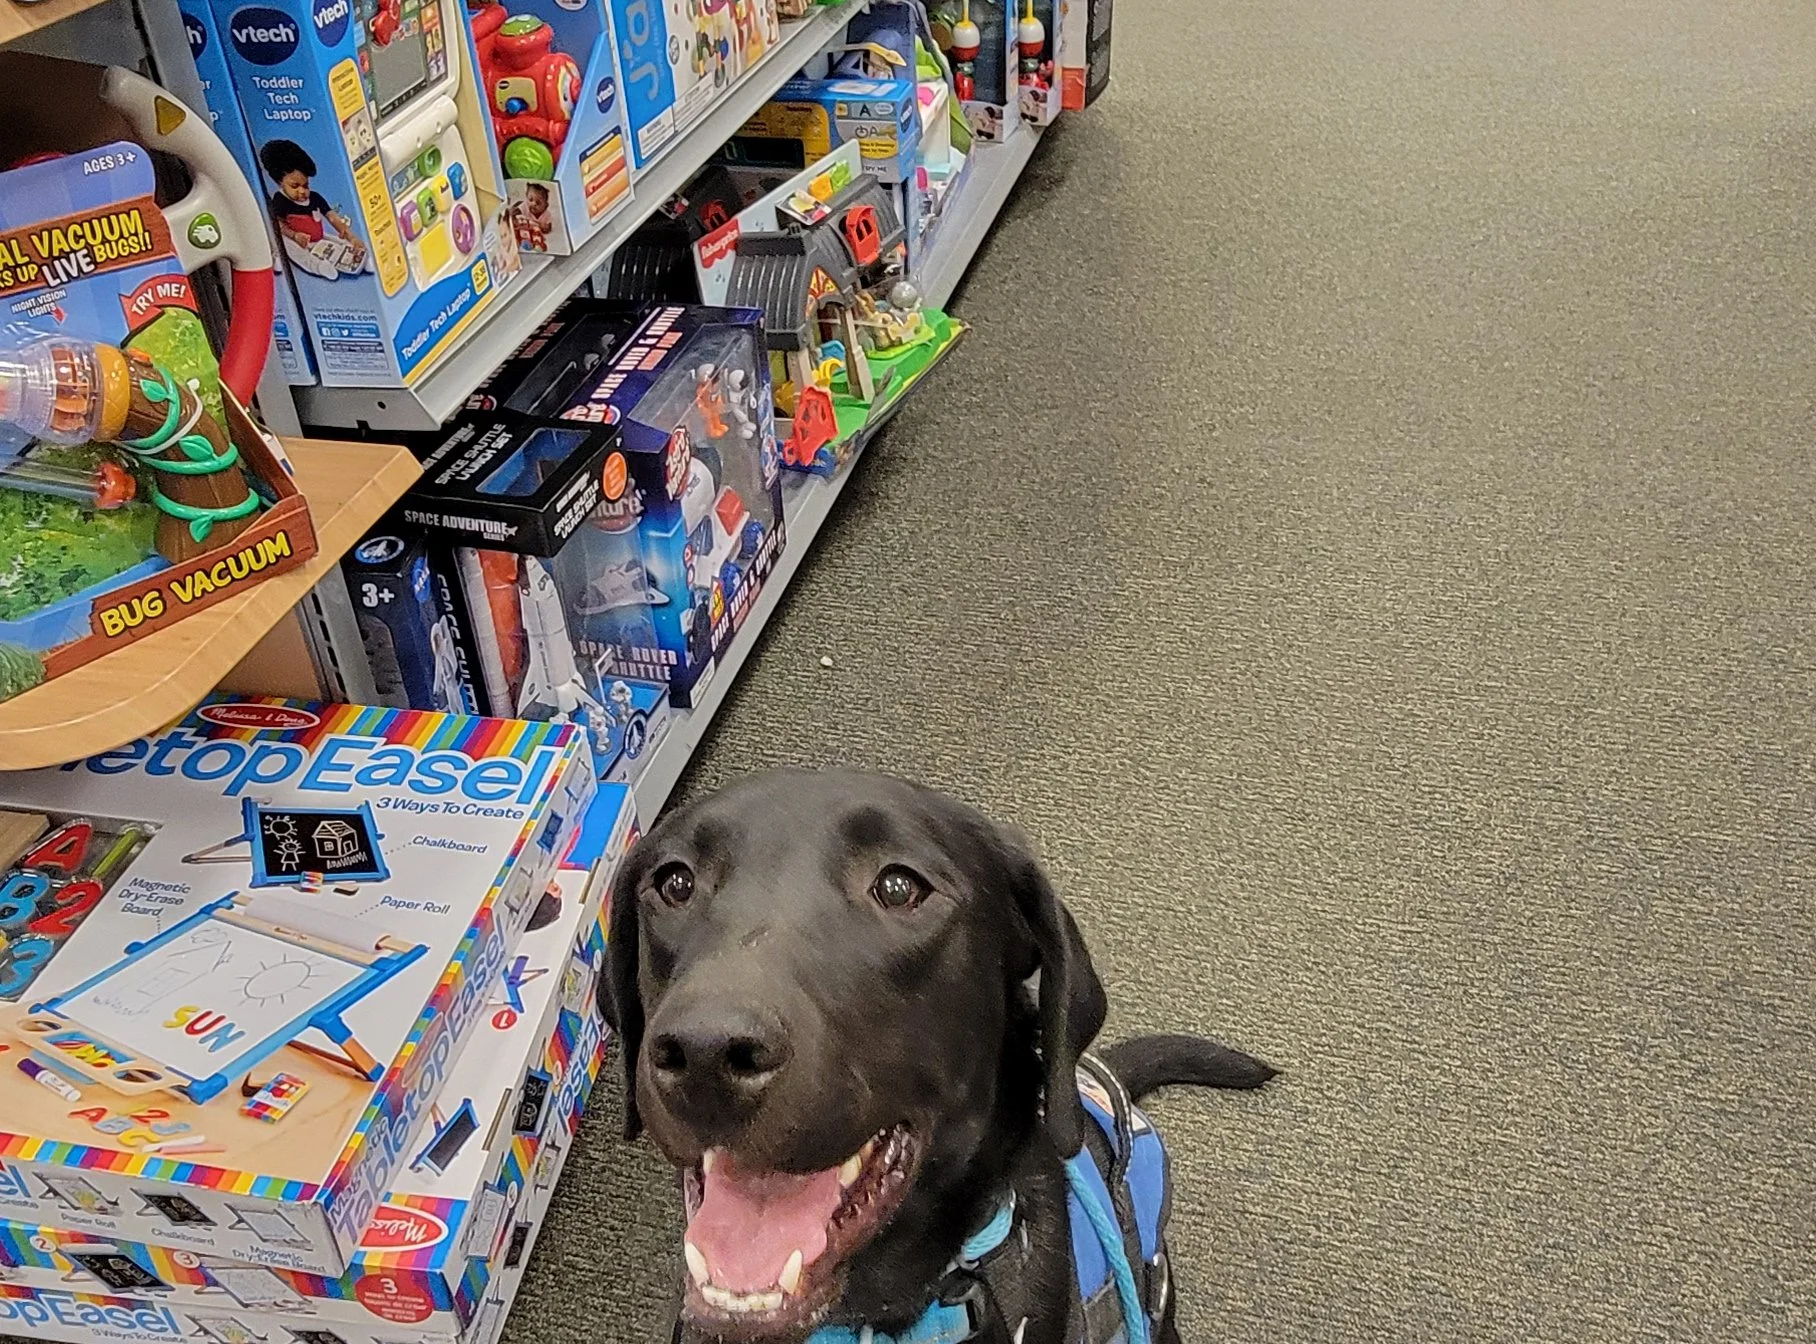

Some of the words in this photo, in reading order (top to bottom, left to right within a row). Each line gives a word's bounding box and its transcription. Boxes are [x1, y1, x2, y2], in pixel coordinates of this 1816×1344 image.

[232, 23, 296, 44] vtech
[252, 76, 304, 89] Toddler
[267, 92, 299, 105] Tech
[264, 108, 312, 122] Laptop
[83, 157, 114, 175] AGES
[117, 151, 138, 166] 3+
[32, 209, 145, 259] VACUUM
[17, 265, 38, 282] UP
[42, 249, 95, 288] LIVE
[93, 231, 153, 263] BUGS!!
[12, 300, 37, 313] NIGHT
[37, 289, 67, 306] VISION
[27, 302, 57, 318] LIGHTS
[131, 289, 155, 316] TRY
[157, 284, 187, 299] ME!
[313, 313, 378, 322] vtechkids.com
[402, 328, 430, 361] Toddler
[429, 311, 448, 335] Tech
[446, 288, 472, 320] Laptop
[491, 432, 513, 449] SET
[434, 455, 469, 485] SPACE
[465, 423, 507, 460] SHUTTLE
[404, 509, 440, 526] SPACE
[442, 514, 509, 535] ADVENTURE
[100, 590, 164, 637] BUG
[170, 531, 291, 603] VACUUM
[362, 582, 395, 607] 3+
[210, 707, 262, 722] Melissa
[297, 736, 558, 806] Easel
[376, 797, 391, 809] 3
[390, 798, 441, 814] Ways
[441, 801, 461, 814] To
[463, 804, 525, 821] Create
[412, 835, 489, 854] Chalkboard
[129, 877, 192, 895] Magnetic
[118, 888, 186, 906] Dry-Erase
[380, 895, 421, 912] Paper
[423, 902, 451, 915] Roll
[121, 903, 165, 917] Board
[162, 1005, 247, 1053] SUN
[334, 1027, 450, 1246] Tabletop
[329, 1116, 389, 1225] Magnetic
[60, 1213, 92, 1227] Paper
[151, 1228, 217, 1247] Chalkboard
[250, 1245, 305, 1263] Magnetic
[380, 1277, 399, 1295] 3
[41, 1293, 182, 1335] Easel
